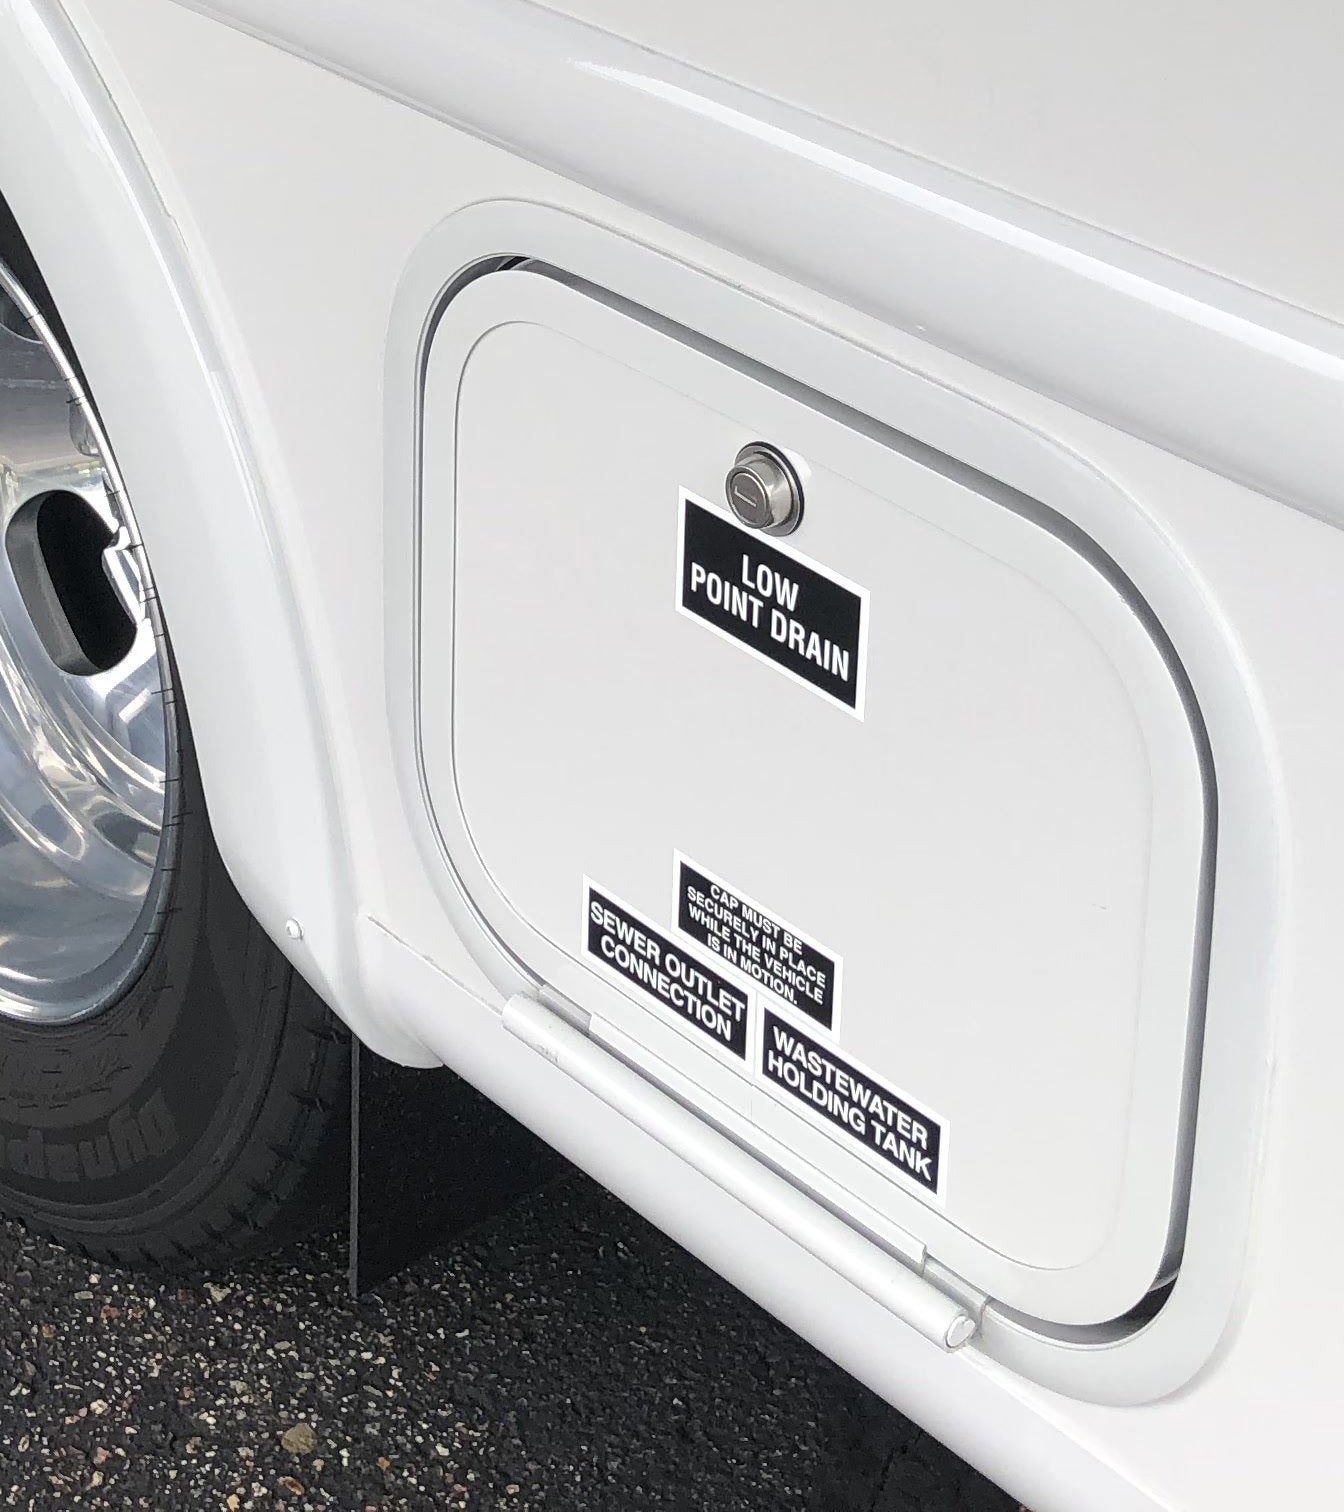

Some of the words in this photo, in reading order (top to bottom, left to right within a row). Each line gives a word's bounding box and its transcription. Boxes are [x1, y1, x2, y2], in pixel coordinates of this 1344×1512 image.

[690, 561, 764, 629] POINT
[770, 607, 850, 683] DRAIN
[742, 553, 800, 612] LOW
[590, 900, 661, 967] SEWER
[664, 952, 746, 1023] OUTLET
[687, 885, 760, 943] SECURELY
[761, 933, 776, 956] IN
[779, 945, 827, 990] PLACE
[688, 902, 732, 943] WHILE
[733, 933, 762, 964] THE
[763, 953, 824, 1006] VEHICLE
[707, 933, 721, 953] IS
[723, 943, 738, 965] IN
[740, 958, 798, 1006] MOTION.
[710, 885, 739, 911] CAP
[741, 903, 781, 939] MUST
[783, 930, 804, 956] BE
[600, 934, 733, 1043] CONNECTION
[767, 1048, 867, 1136] HOLDING
[869, 1118, 933, 1182] TANK
[772, 1025, 929, 1151] WASTEWATER
